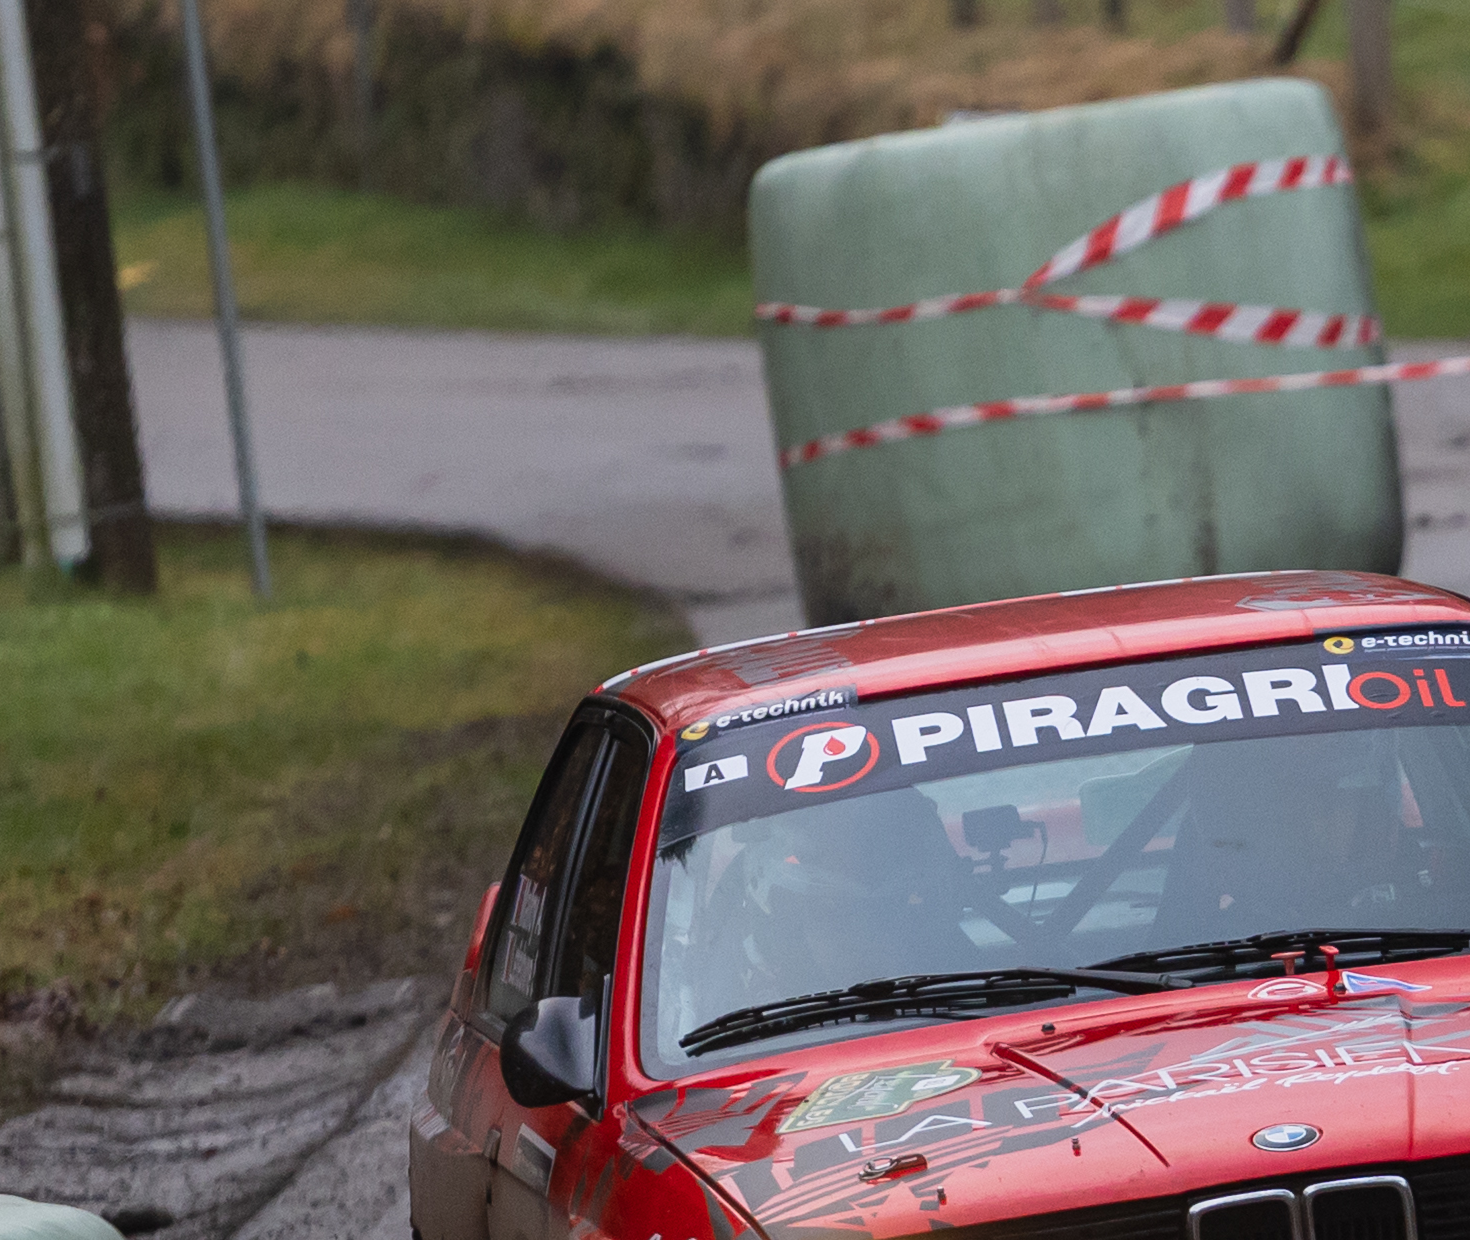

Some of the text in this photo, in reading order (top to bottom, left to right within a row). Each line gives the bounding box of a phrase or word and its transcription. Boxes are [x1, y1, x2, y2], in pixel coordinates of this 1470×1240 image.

[715, 690, 845, 728] e-technik
[702, 762, 726, 786] A
[838, 1114, 993, 1152] LA
